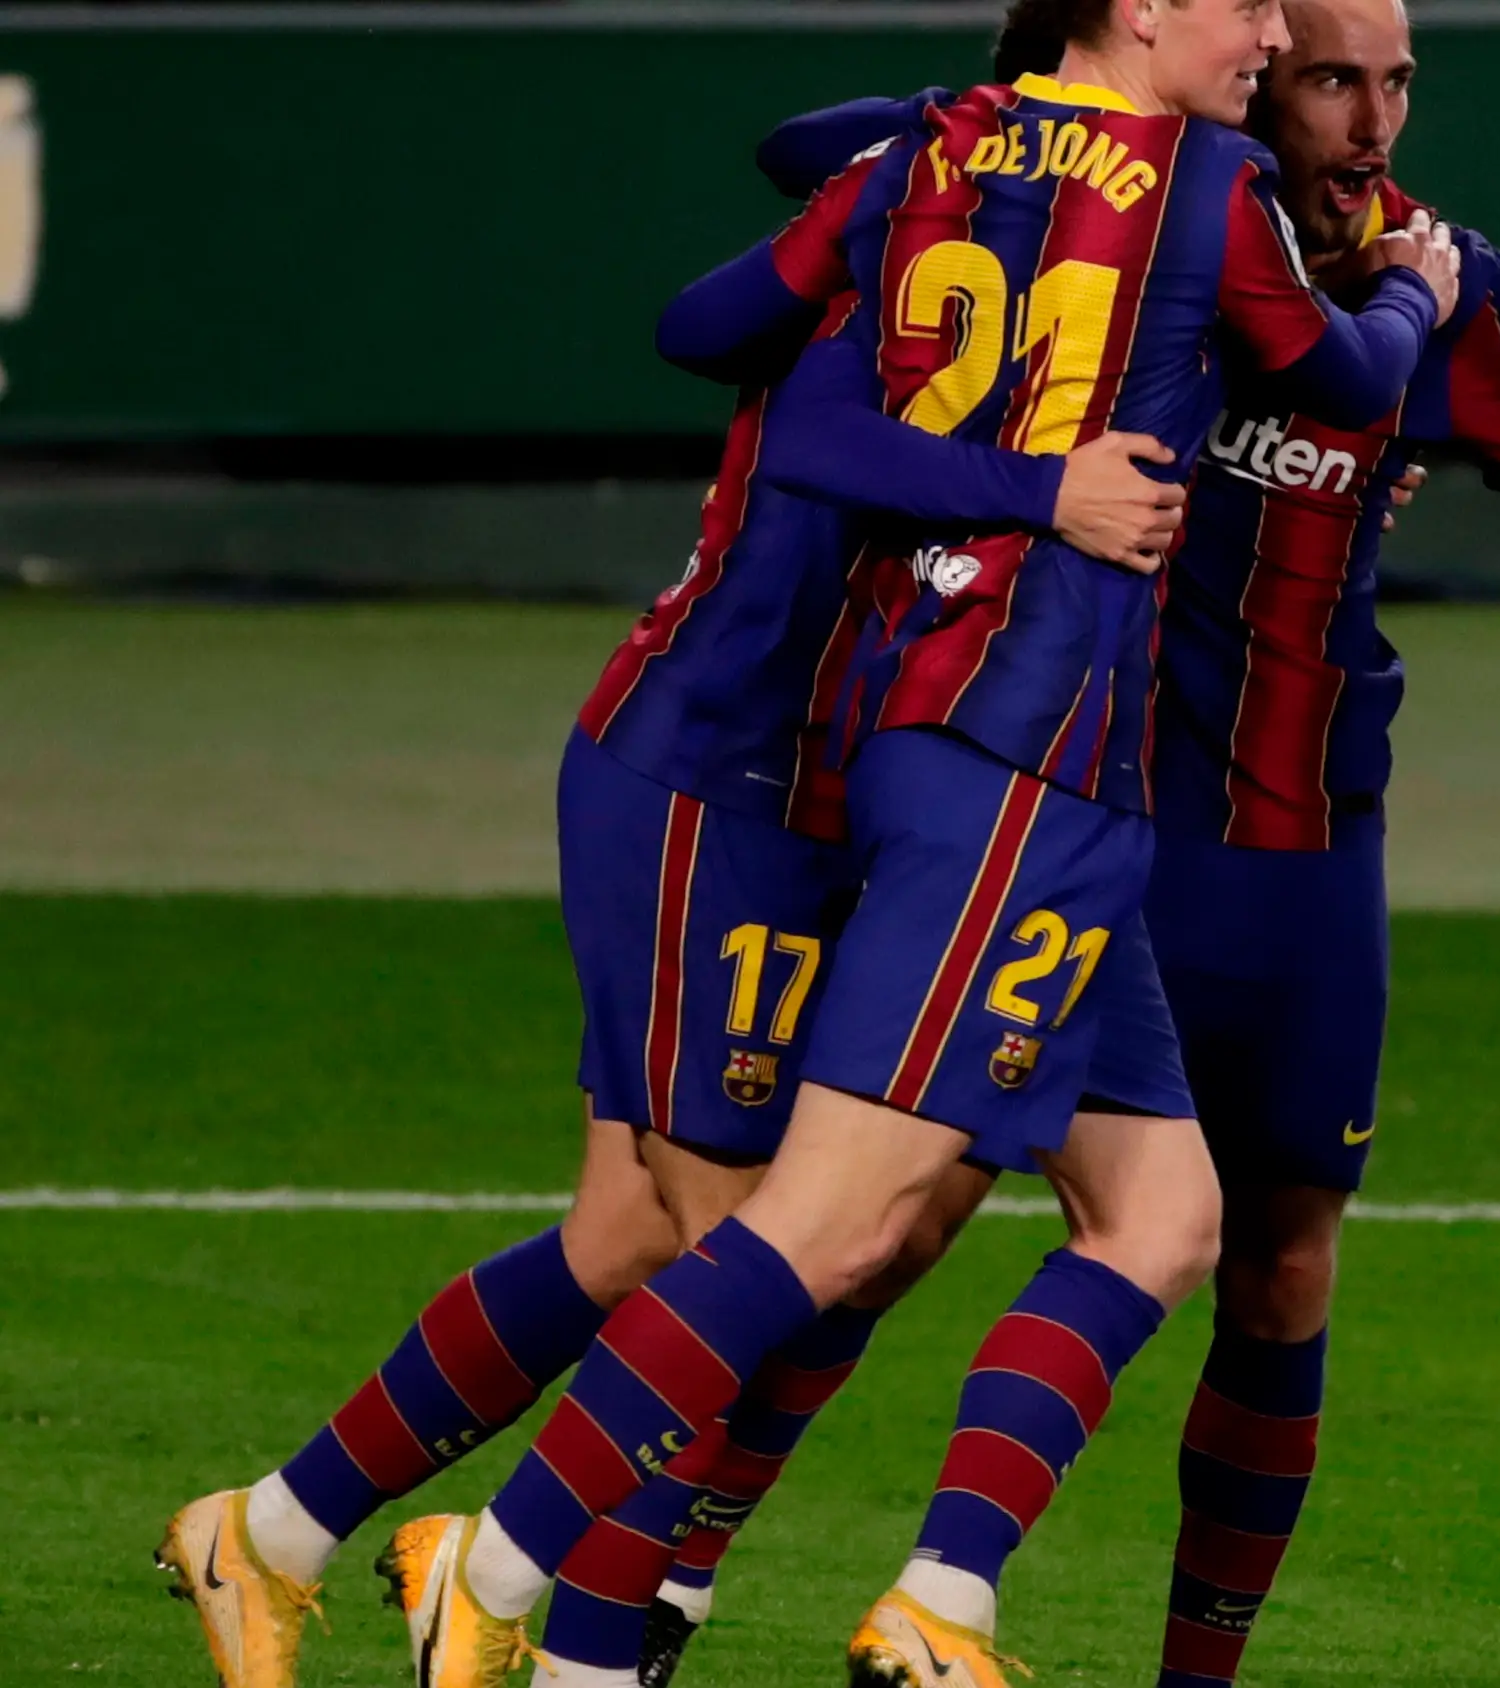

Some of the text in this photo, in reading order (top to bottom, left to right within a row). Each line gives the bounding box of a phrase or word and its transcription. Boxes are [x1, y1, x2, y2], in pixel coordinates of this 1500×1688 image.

[926, 135, 961, 196] F.
[963, 122, 1027, 176] DE
[1023, 119, 1159, 213] JONG
[896, 240, 1121, 457] 21
[1206, 407, 1357, 494] uten
[719, 922, 821, 1046] 17
[984, 908, 1112, 1032] 21
